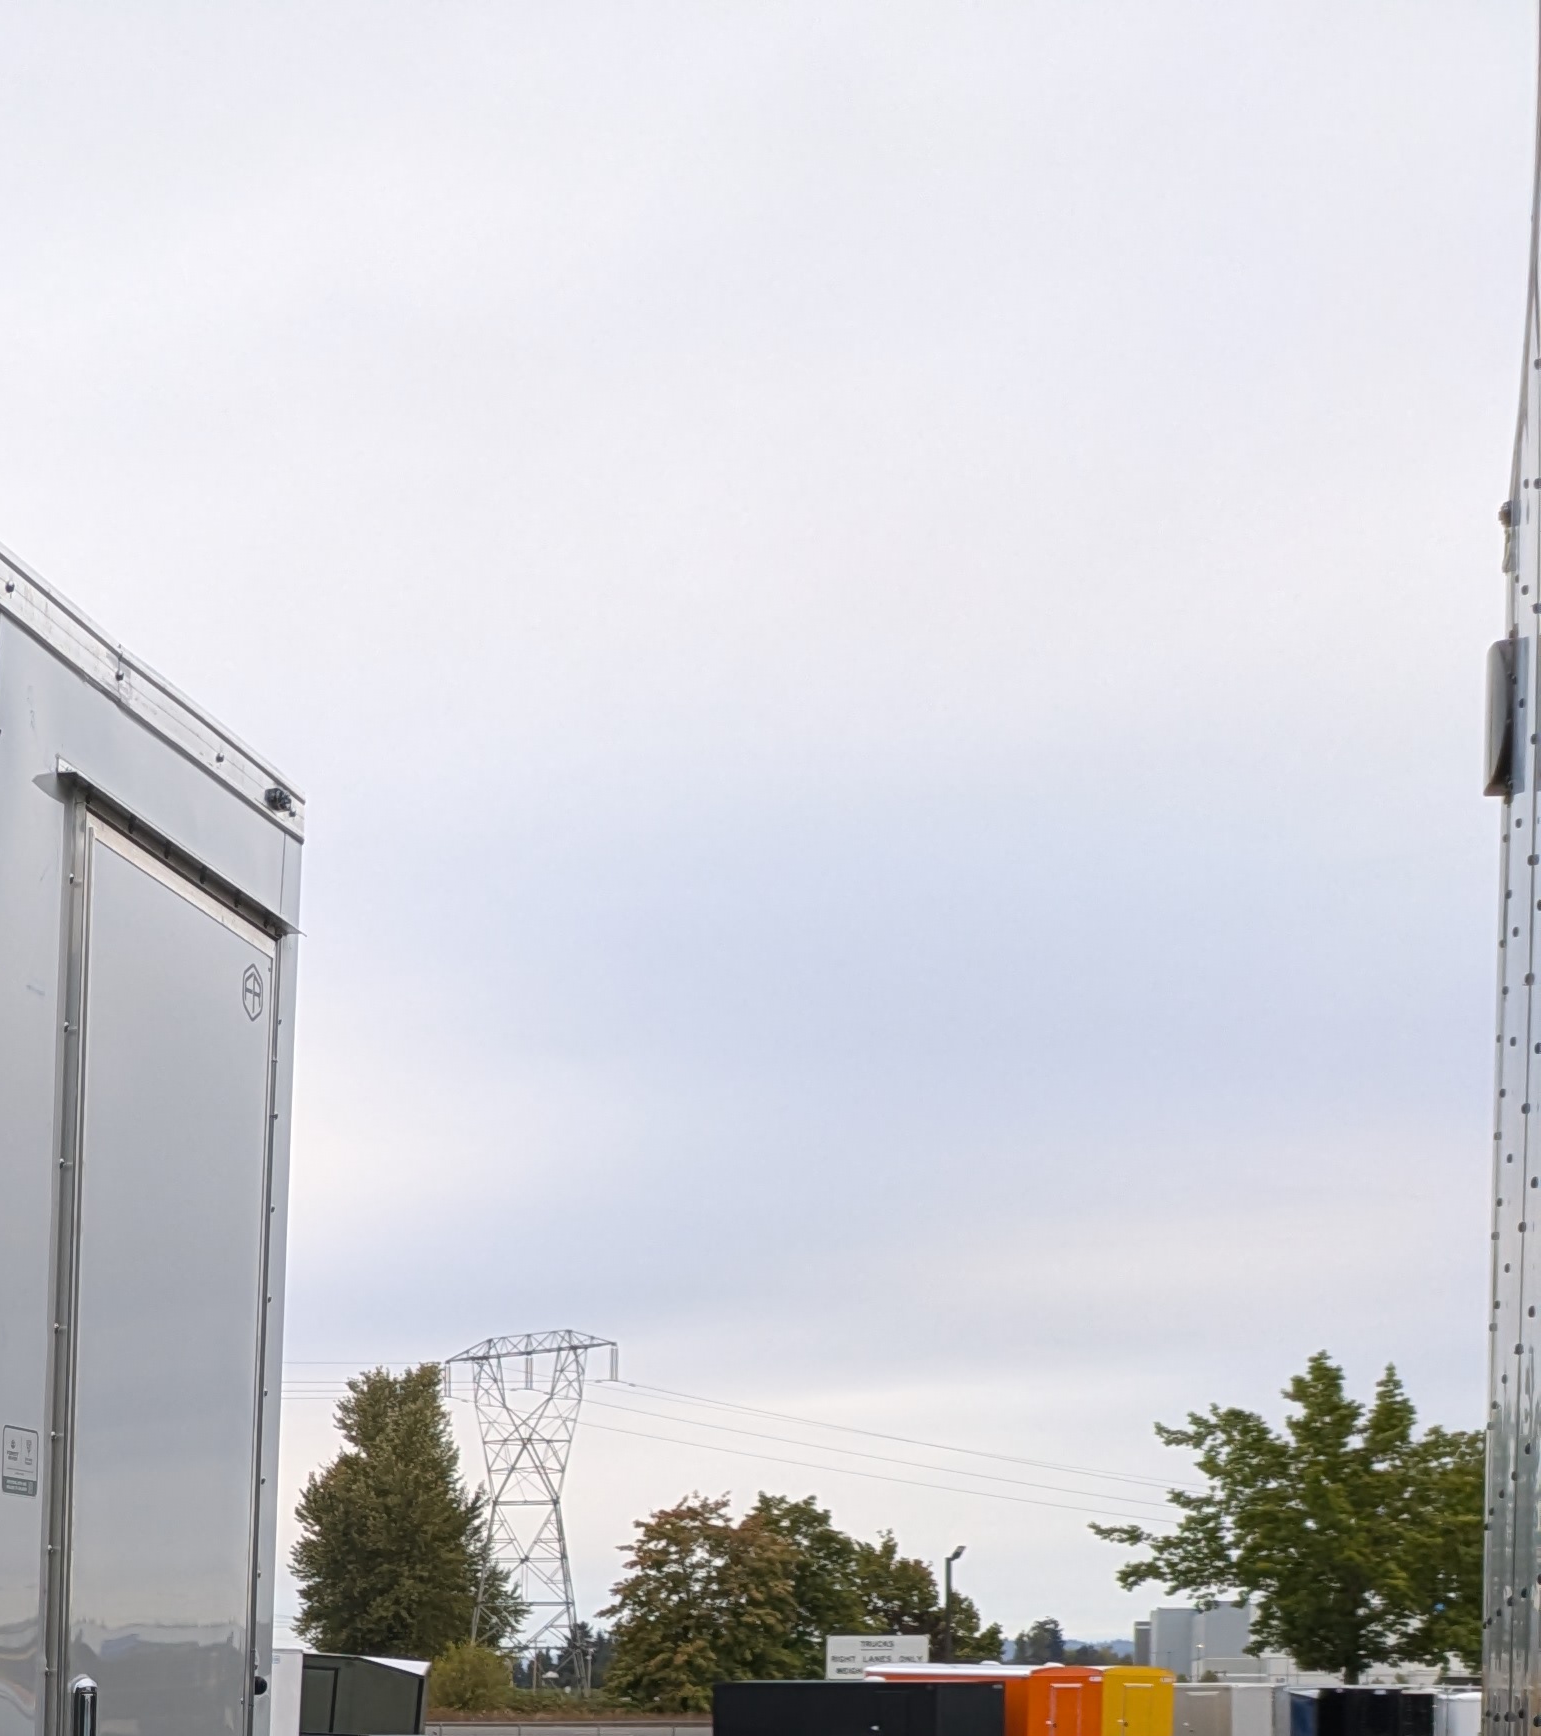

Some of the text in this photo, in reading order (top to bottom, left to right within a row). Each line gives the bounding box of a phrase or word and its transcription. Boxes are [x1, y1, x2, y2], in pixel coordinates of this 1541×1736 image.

[831, 1655, 923, 1663] RIGHT LANES ONLY
